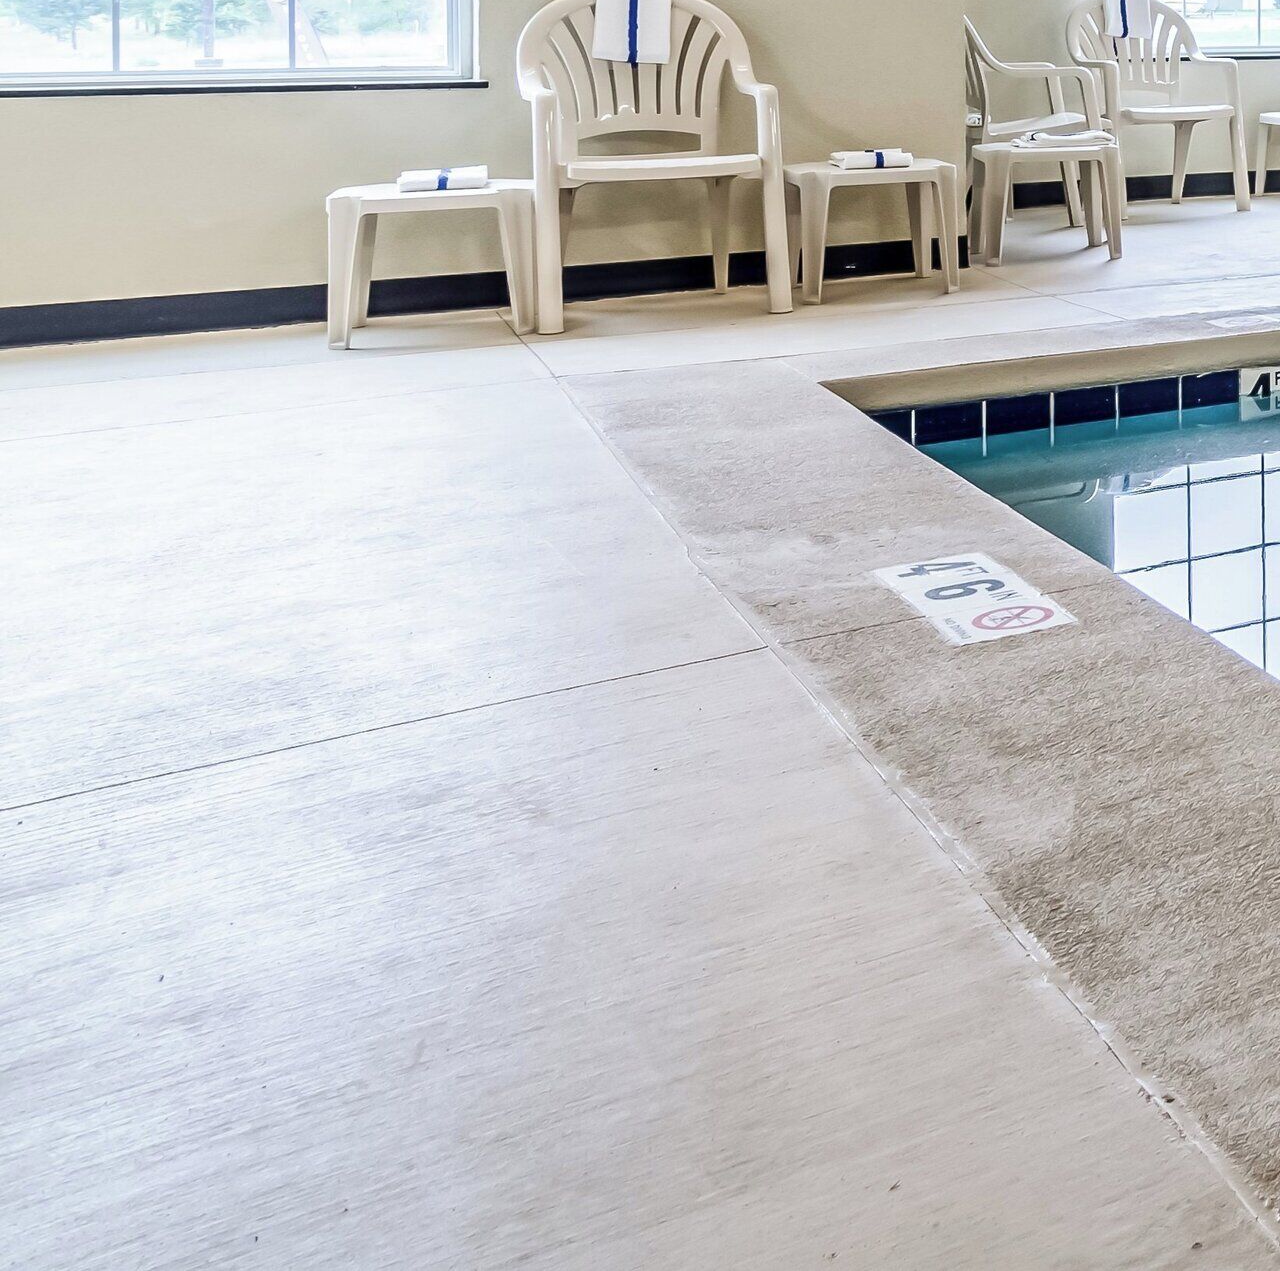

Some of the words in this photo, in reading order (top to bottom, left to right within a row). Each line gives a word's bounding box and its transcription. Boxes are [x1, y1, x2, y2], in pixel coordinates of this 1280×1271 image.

[1248, 372, 1271, 397] 4
[897, 561, 976, 578] 4
[962, 566, 989, 577] FT
[924, 579, 1005, 600] 6
[989, 589, 1022, 601] IN
